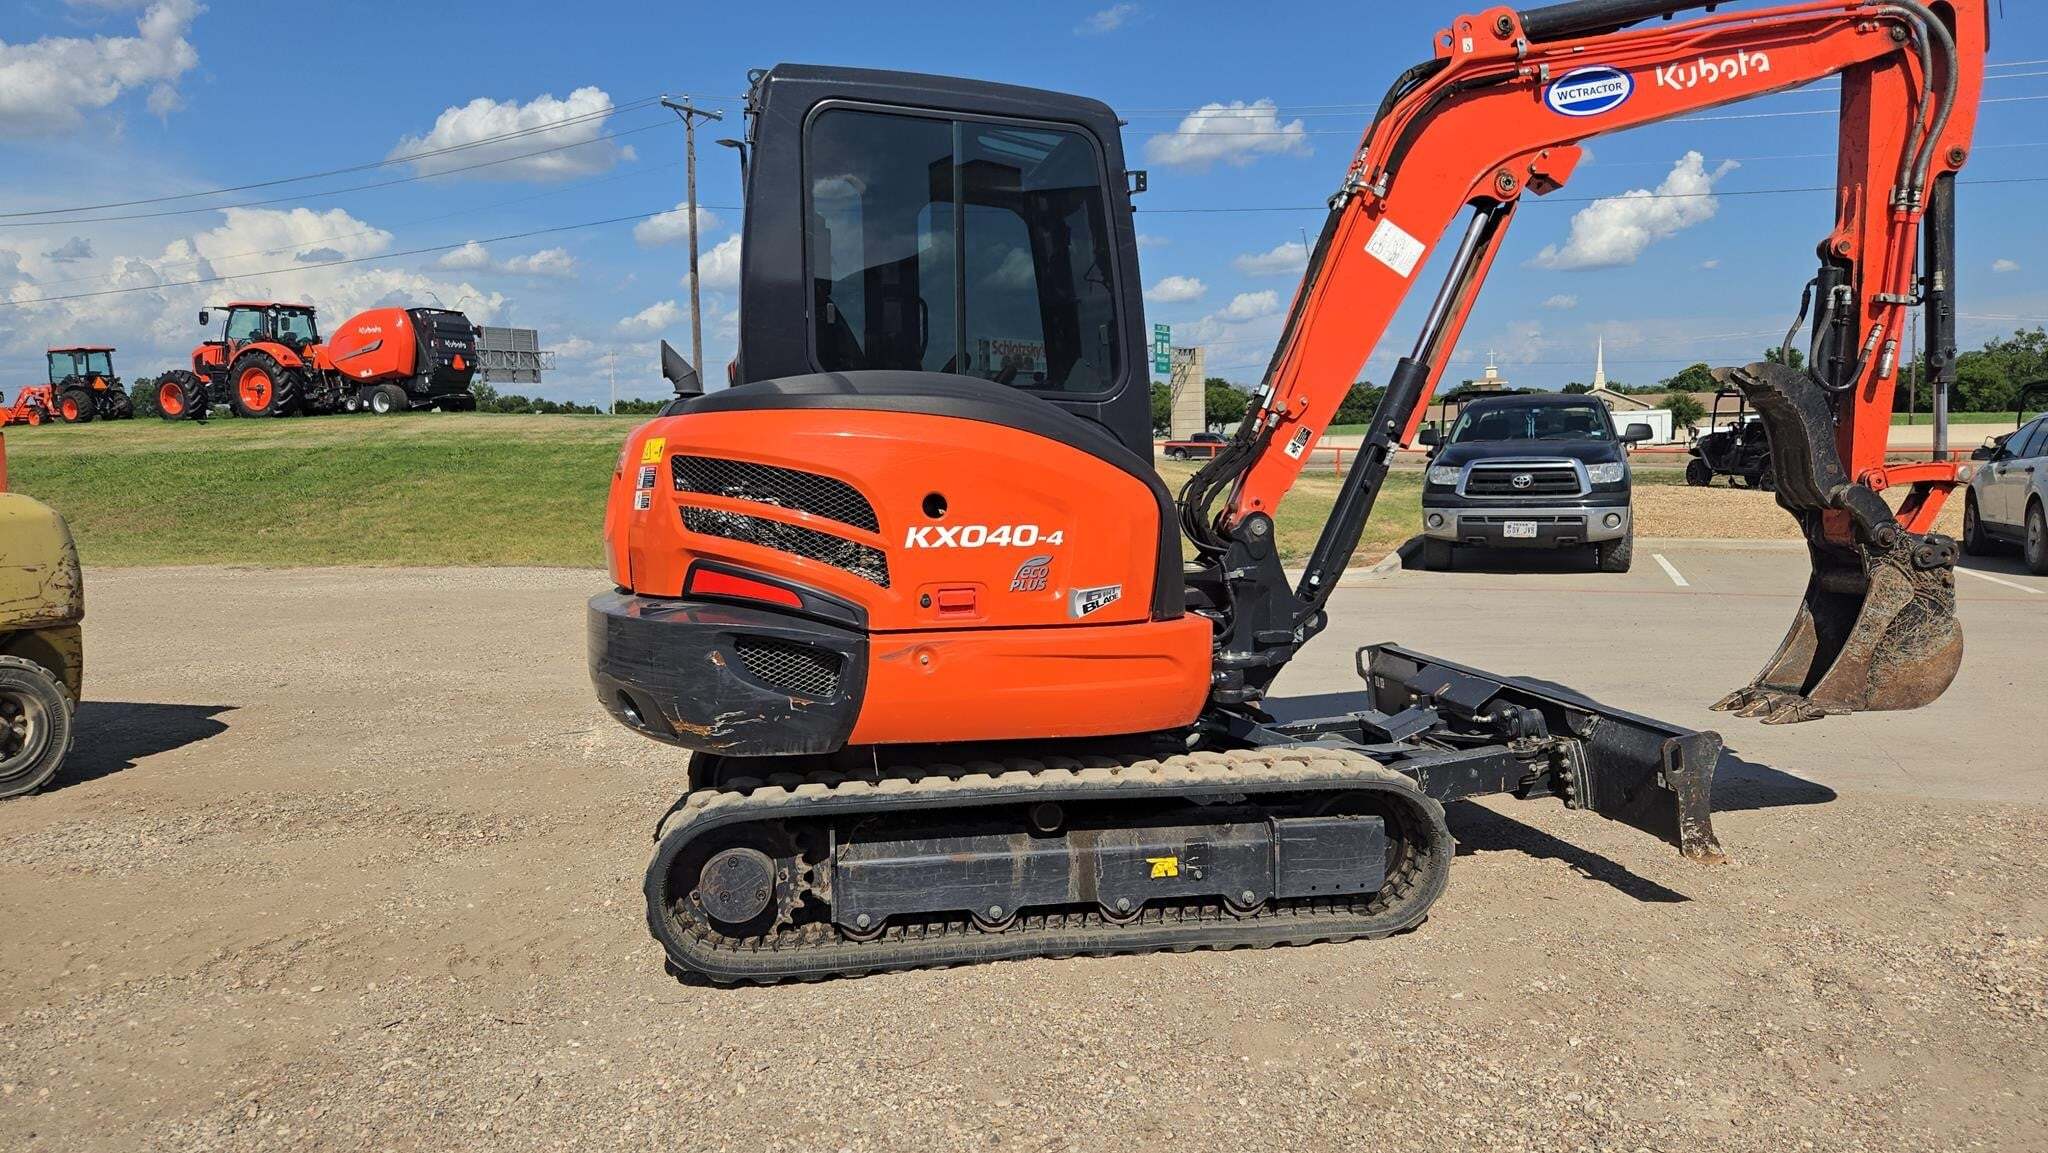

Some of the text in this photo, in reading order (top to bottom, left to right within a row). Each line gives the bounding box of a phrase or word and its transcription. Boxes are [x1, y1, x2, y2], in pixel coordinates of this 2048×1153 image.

[1655, 49, 1771, 90] Kubota
[1557, 81, 1624, 101] WCTRACTOR
[904, 525, 1064, 549] KX040-4
[1020, 566, 1050, 579] eco
[1009, 578, 1048, 592] PLUS
[1082, 593, 1120, 614] BLADE
